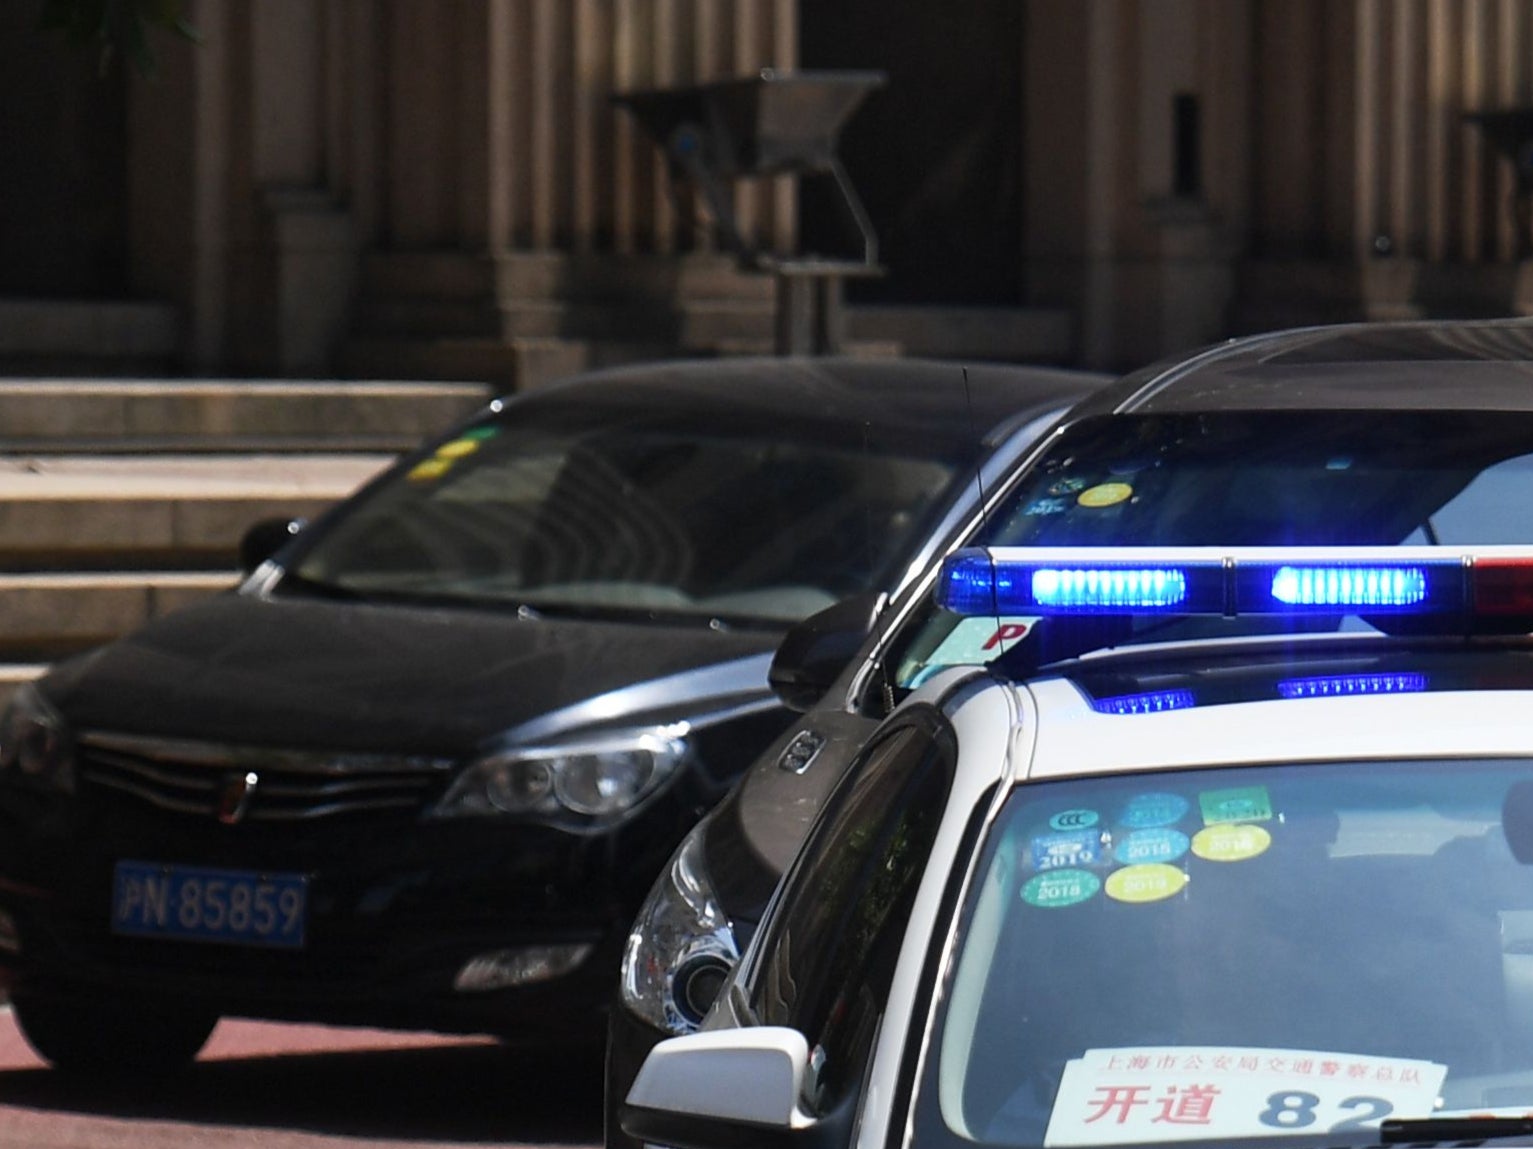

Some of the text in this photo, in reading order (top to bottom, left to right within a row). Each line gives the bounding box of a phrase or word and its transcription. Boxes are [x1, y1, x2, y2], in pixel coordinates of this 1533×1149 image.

[1105, 1055, 1422, 1086] 上海市公安局交通警察总队
[1084, 1084, 1395, 1133] 开道 82
